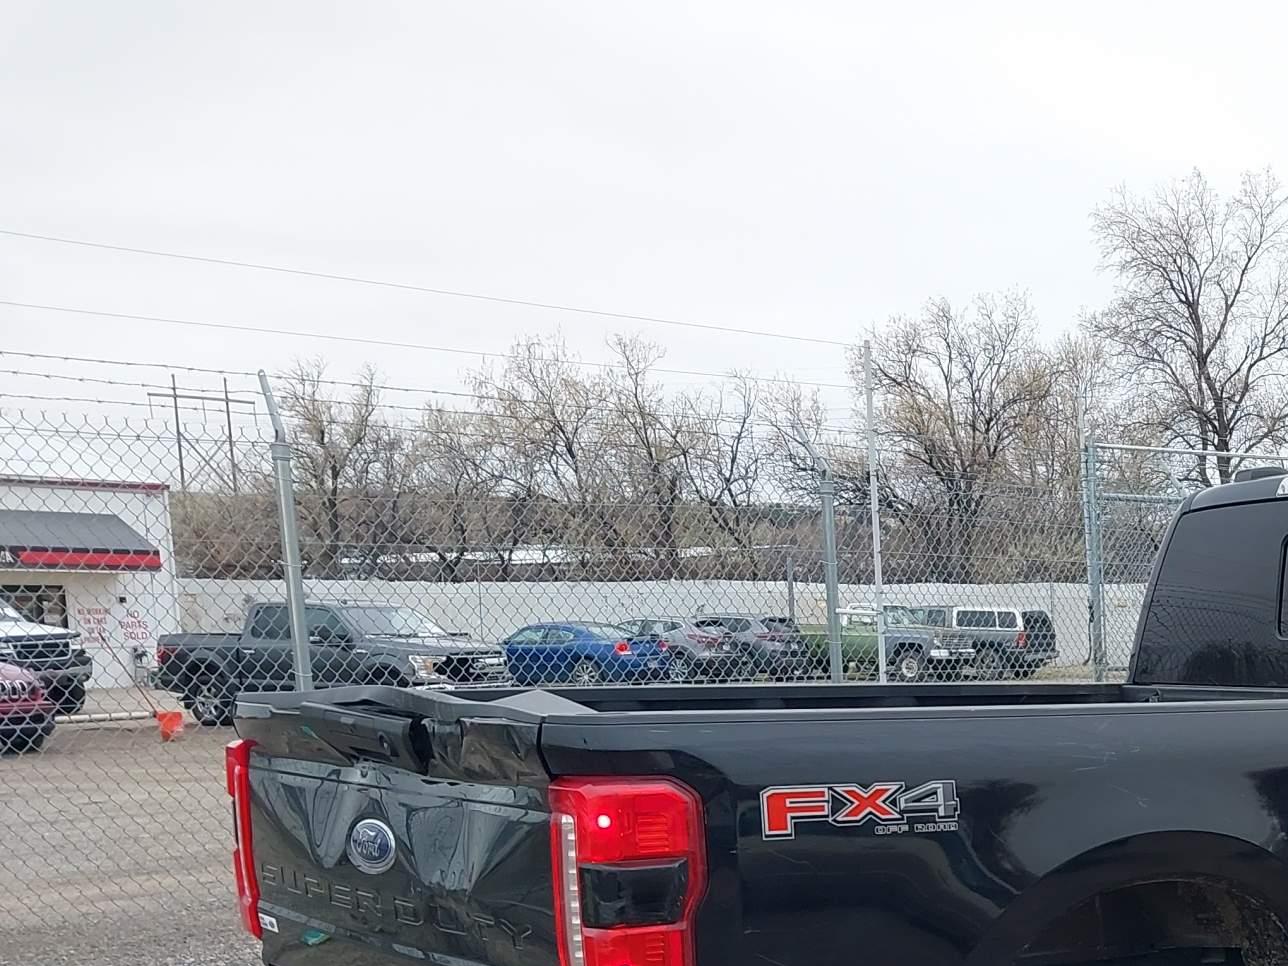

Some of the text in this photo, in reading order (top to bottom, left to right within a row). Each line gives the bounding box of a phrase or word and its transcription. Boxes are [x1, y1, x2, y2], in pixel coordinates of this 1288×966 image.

[127, 610, 140, 619] NO
[120, 620, 148, 629] PARTS
[123, 631, 148, 640] SOLD
[760, 780, 960, 840] FX4
[874, 822, 958, 835] OFF ROAD
[261, 863, 385, 917] SUPER
